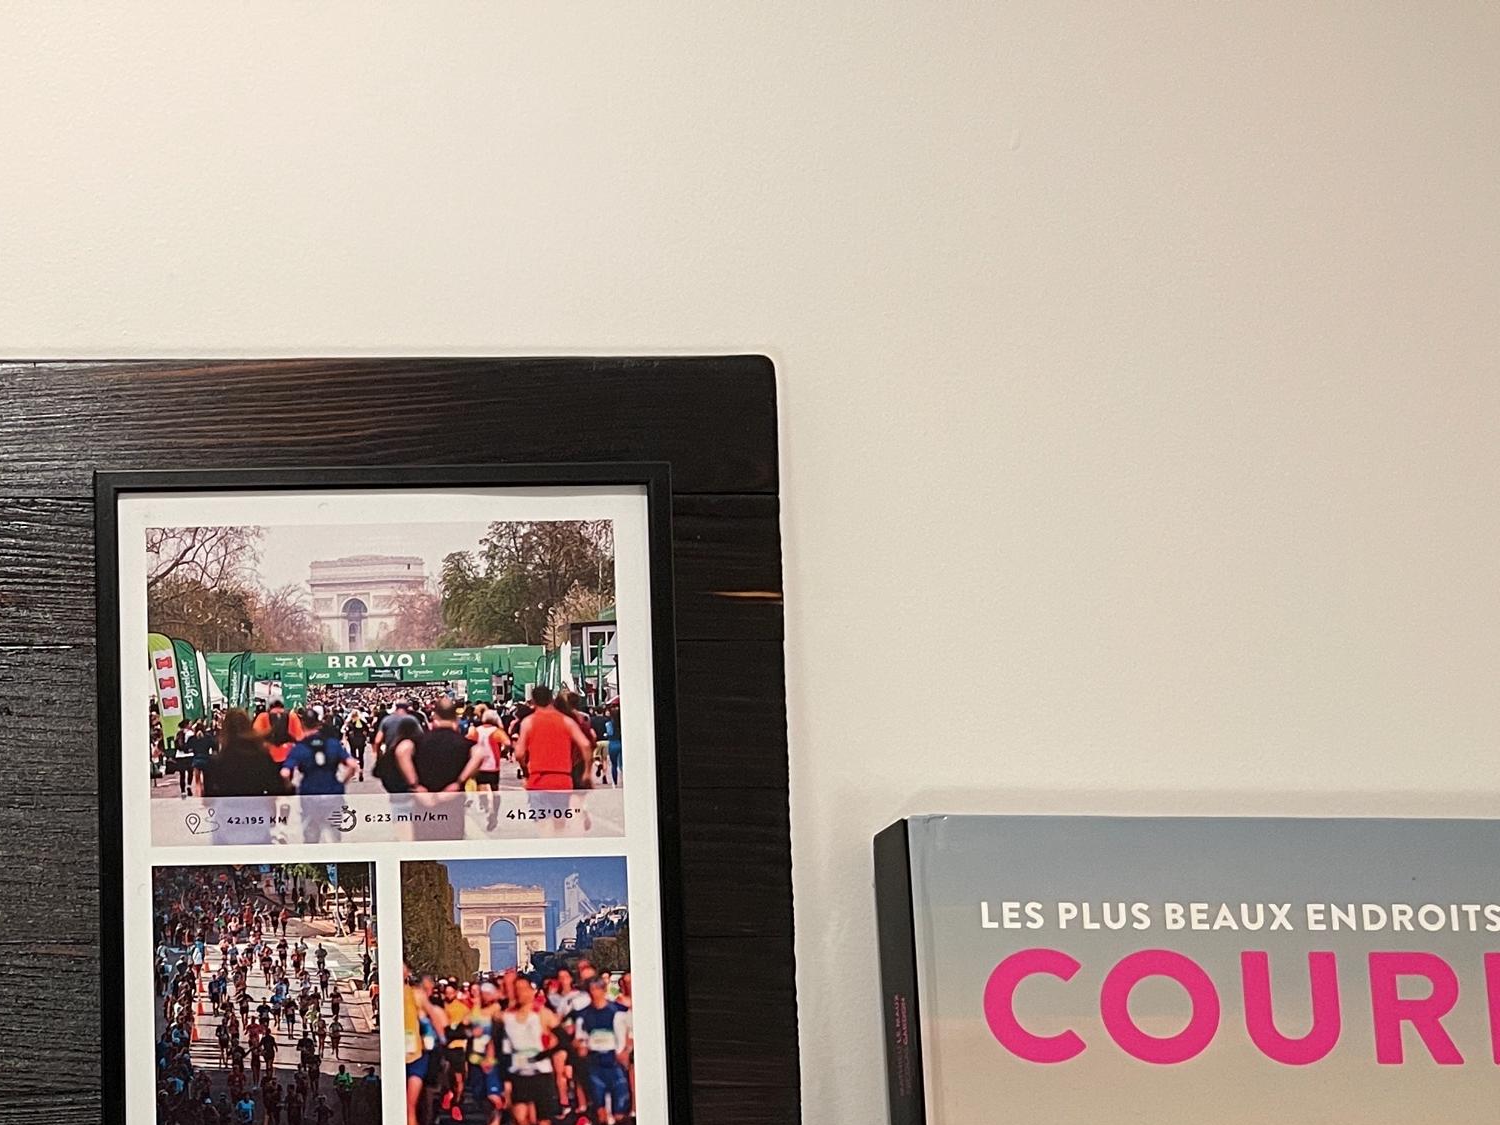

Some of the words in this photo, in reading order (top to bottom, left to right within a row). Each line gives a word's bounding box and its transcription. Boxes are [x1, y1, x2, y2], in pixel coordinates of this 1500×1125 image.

[327, 653, 413, 668] BRAVO
[364, 814, 391, 822] 6:23
[397, 811, 448, 822] min/km
[506, 809, 581, 820] 4h23'06"
[227, 816, 264, 825] 42.195
[269, 816, 287, 825] KM
[981, 901, 1044, 929] LES
[1058, 902, 1151, 930] PLUS
[1165, 903, 1293, 930] BEAUX
[1307, 903, 1500, 932] ENDROITS
